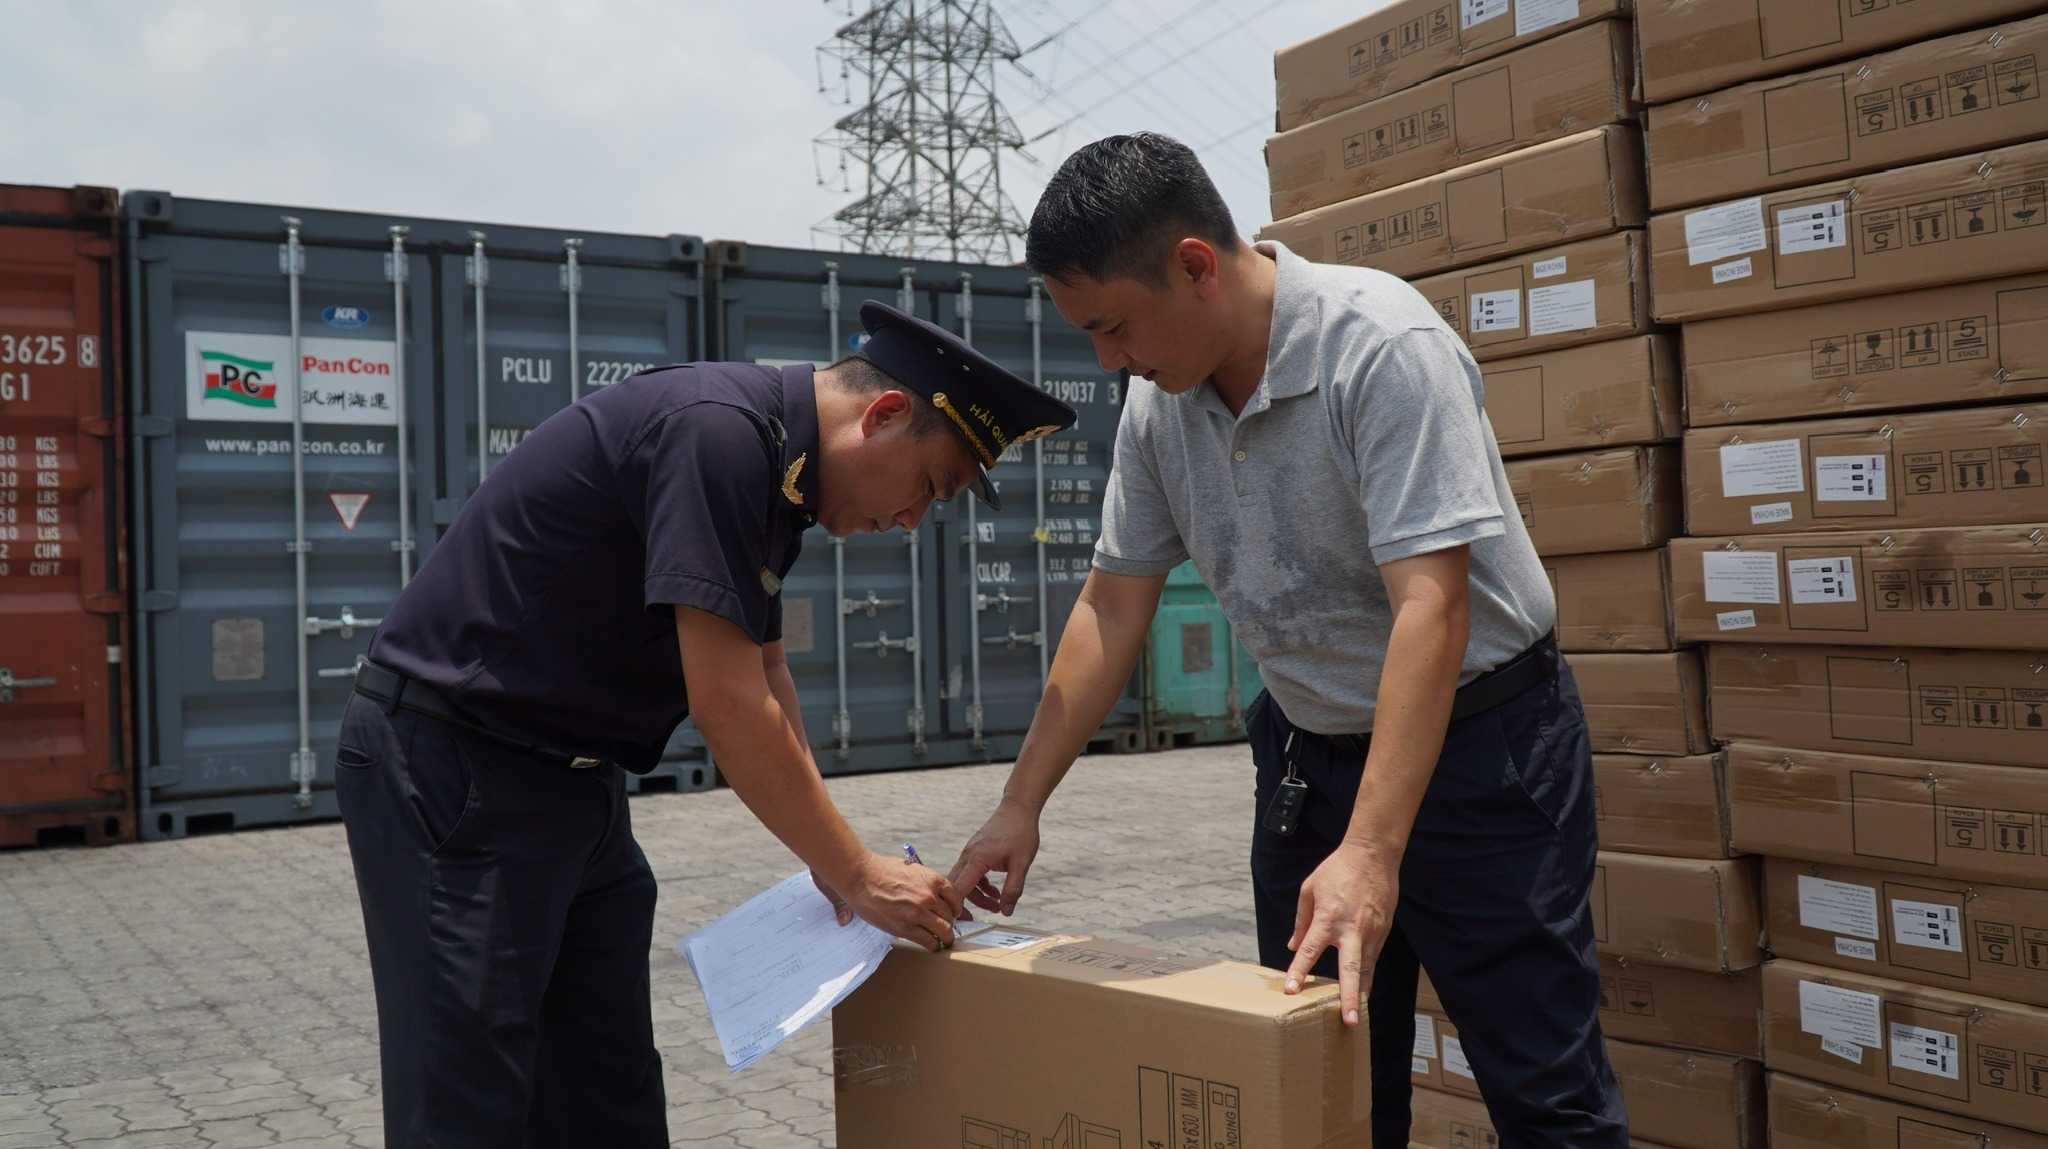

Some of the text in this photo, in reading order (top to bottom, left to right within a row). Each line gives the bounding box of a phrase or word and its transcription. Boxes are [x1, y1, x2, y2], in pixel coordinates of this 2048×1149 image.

[1868, 113, 1883, 132] 5
[1873, 232, 1888, 249] 5
[1960, 320, 1976, 338] 5
[1, 335, 94, 366] 3625 8
[221, 364, 262, 394] PC
[502, 357, 552, 384] PCLU
[0, 372, 29, 401] G1
[1106, 383, 1120, 405] 3
[1916, 474, 1931, 491] 5
[1885, 591, 1900, 608] 5
[1932, 707, 1946, 723] 5
[1956, 829, 1973, 846] 5
[1988, 944, 2004, 961] 5
[1989, 1068, 2004, 1086] 5
[1181, 1087, 1199, 1109] MM
